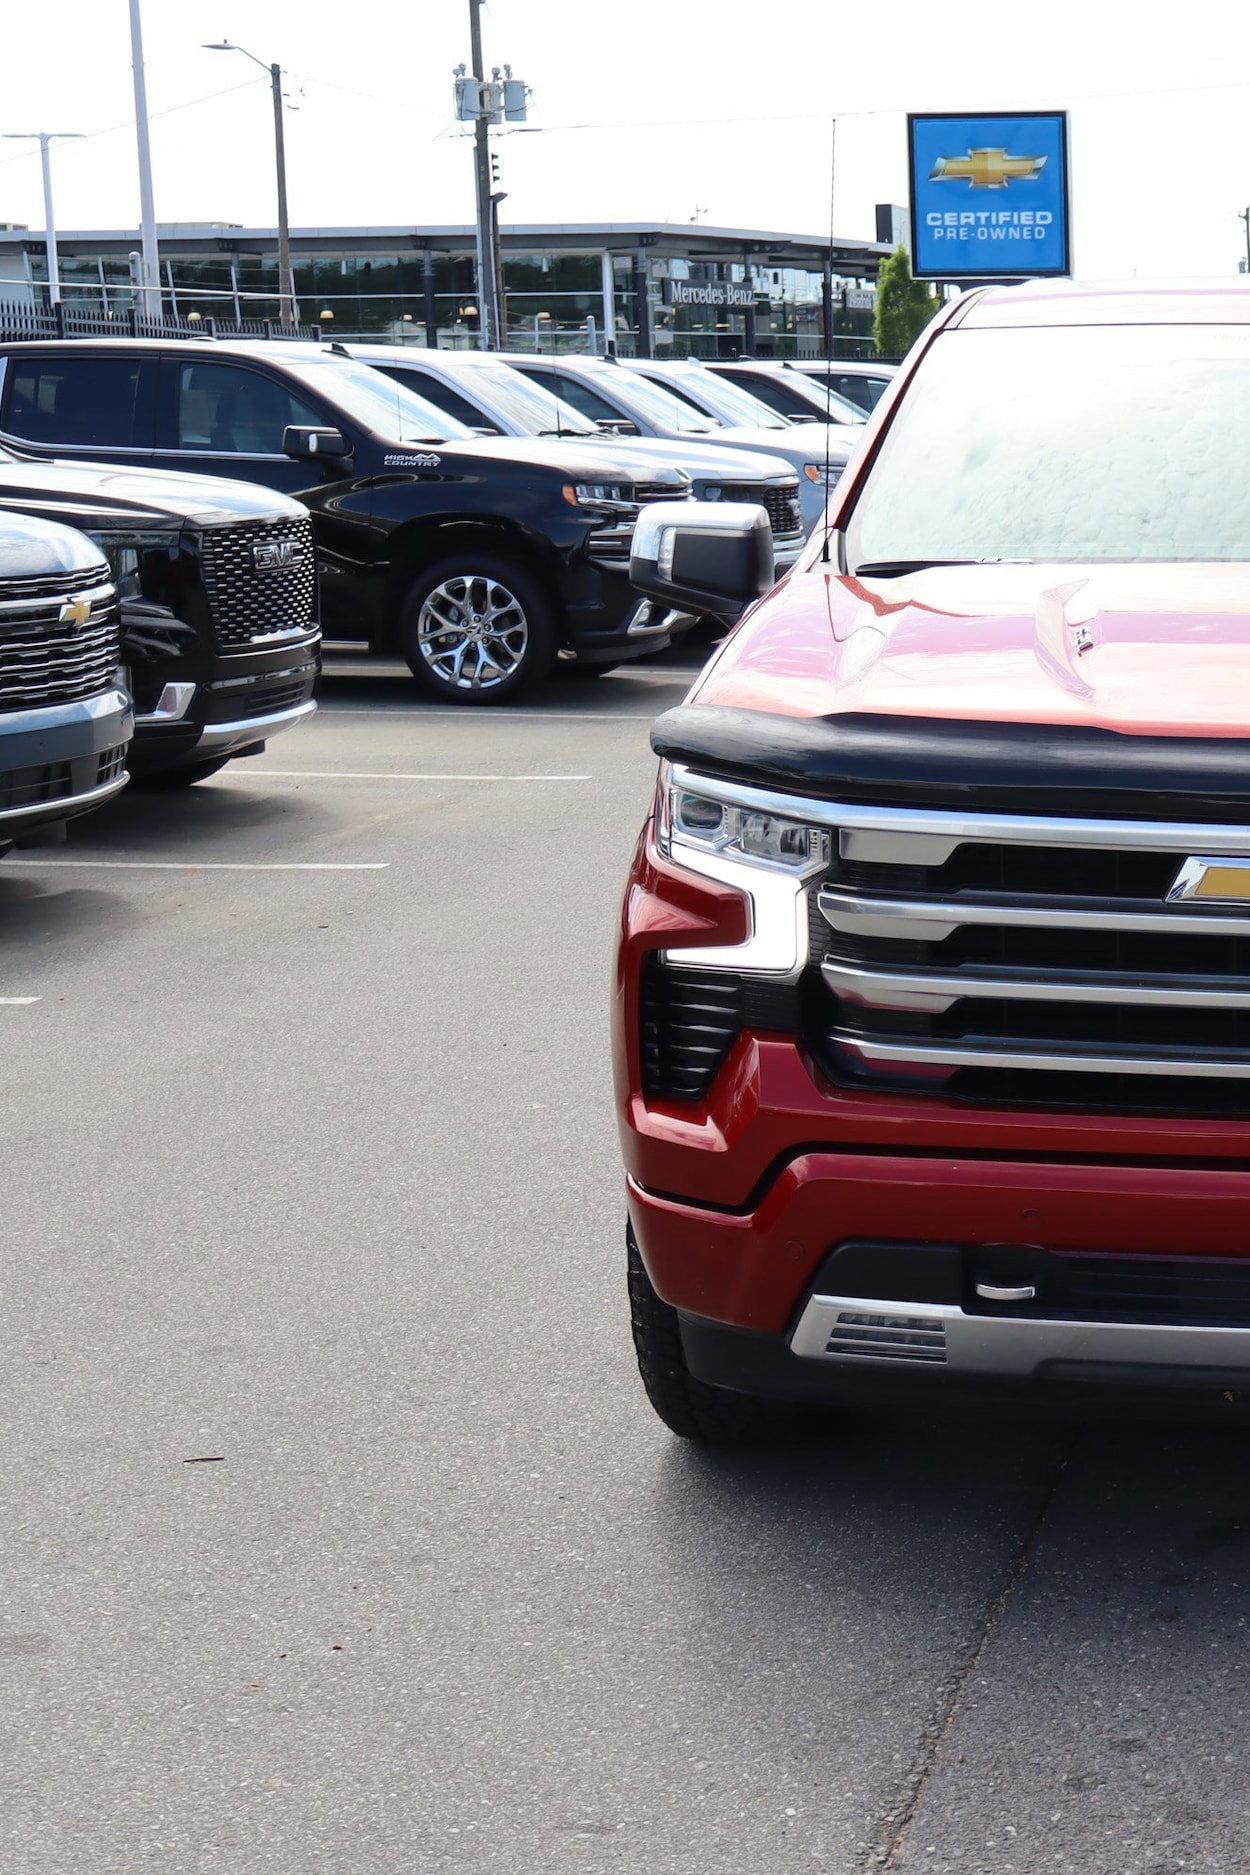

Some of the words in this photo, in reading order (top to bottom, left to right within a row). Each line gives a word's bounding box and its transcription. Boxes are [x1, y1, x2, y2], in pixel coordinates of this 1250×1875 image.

[926, 211, 1053, 226] CERTIFIED
[934, 227, 1046, 240] PRE-OWNED
[670, 280, 753, 305] Mercedes-Benz
[253, 541, 305, 569] GMC
